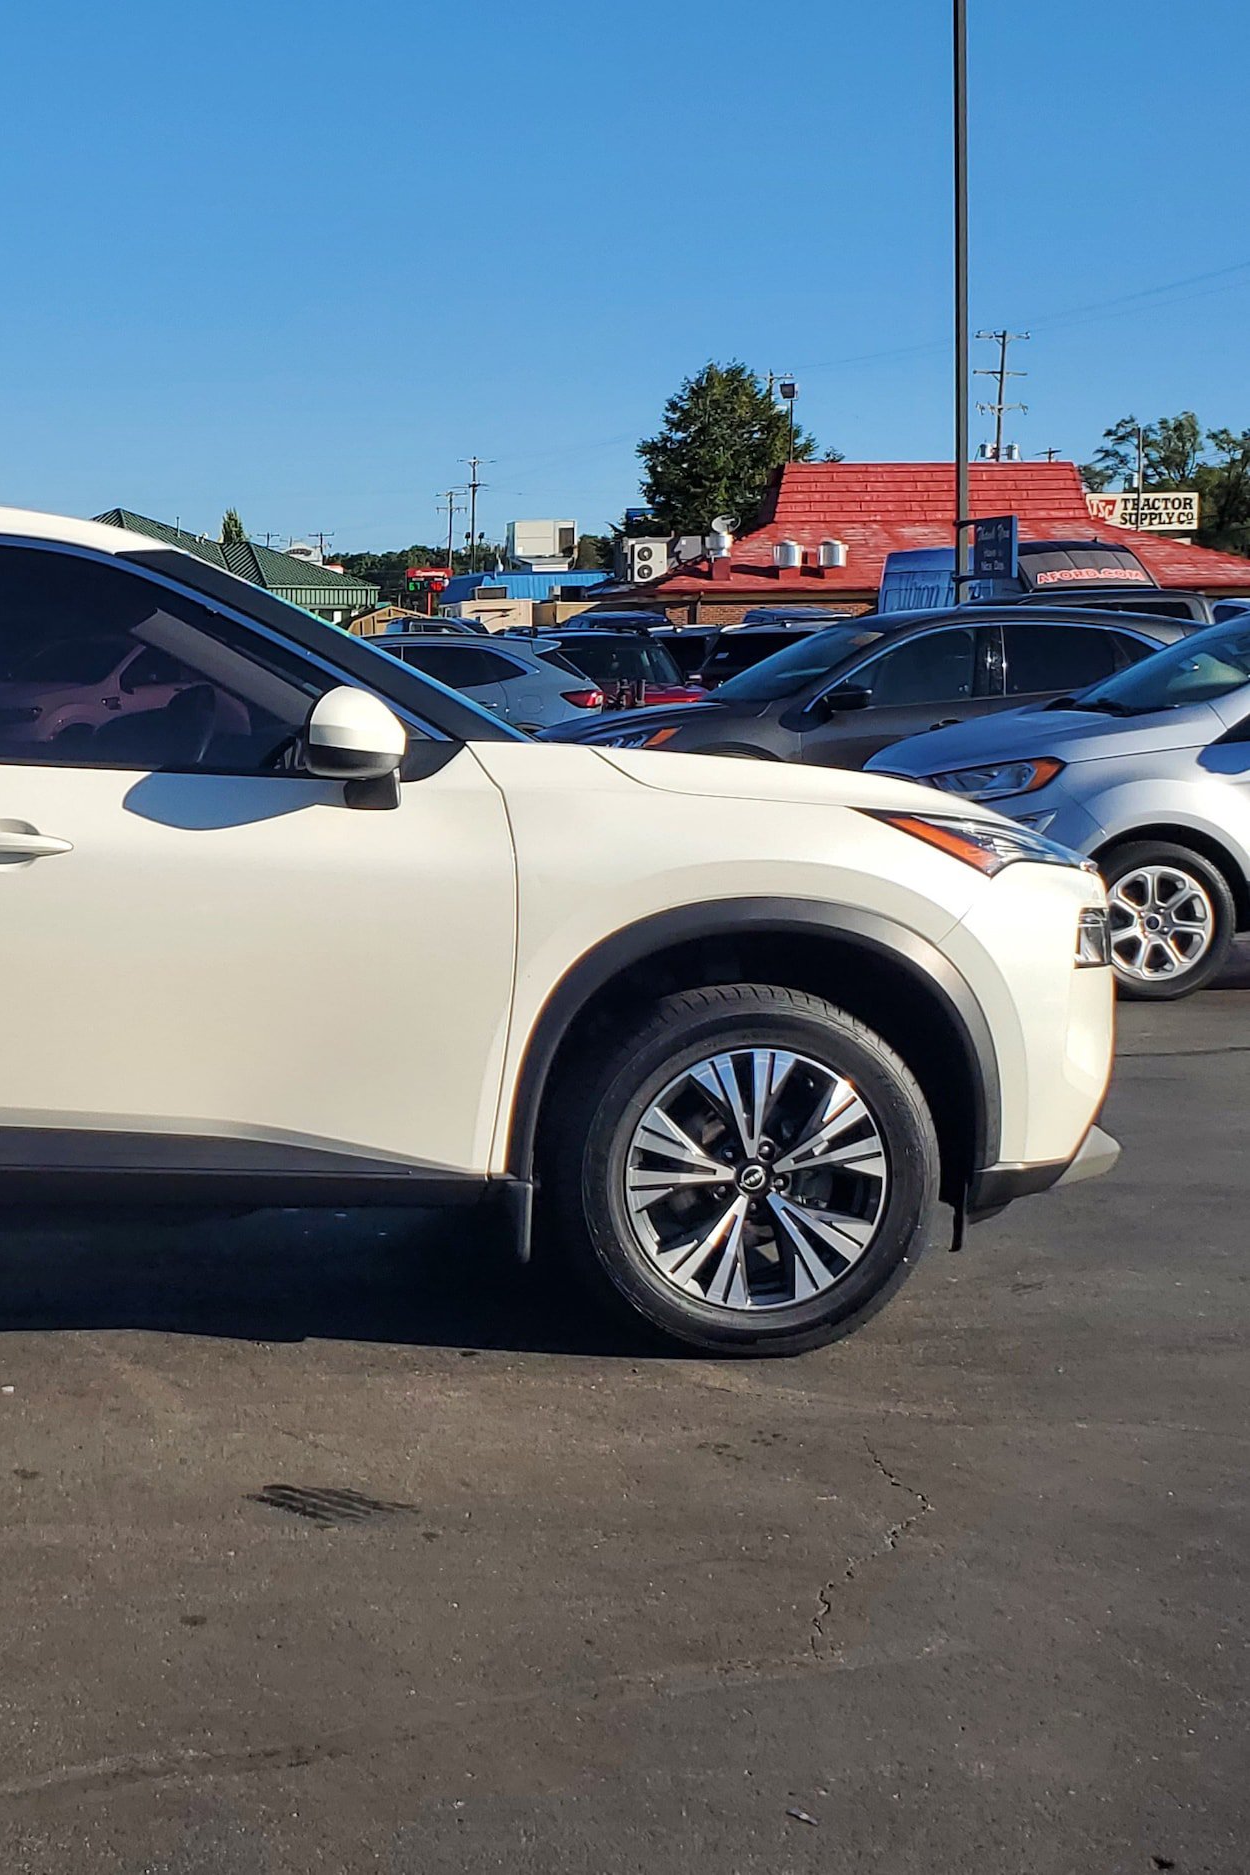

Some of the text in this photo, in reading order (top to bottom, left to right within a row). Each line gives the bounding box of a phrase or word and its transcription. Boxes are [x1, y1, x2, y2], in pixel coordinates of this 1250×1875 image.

[1090, 500, 1113, 521] TSC
[1120, 512, 1174, 525] SUPPLY
[1037, 568, 1146, 584] AFORD.COM
